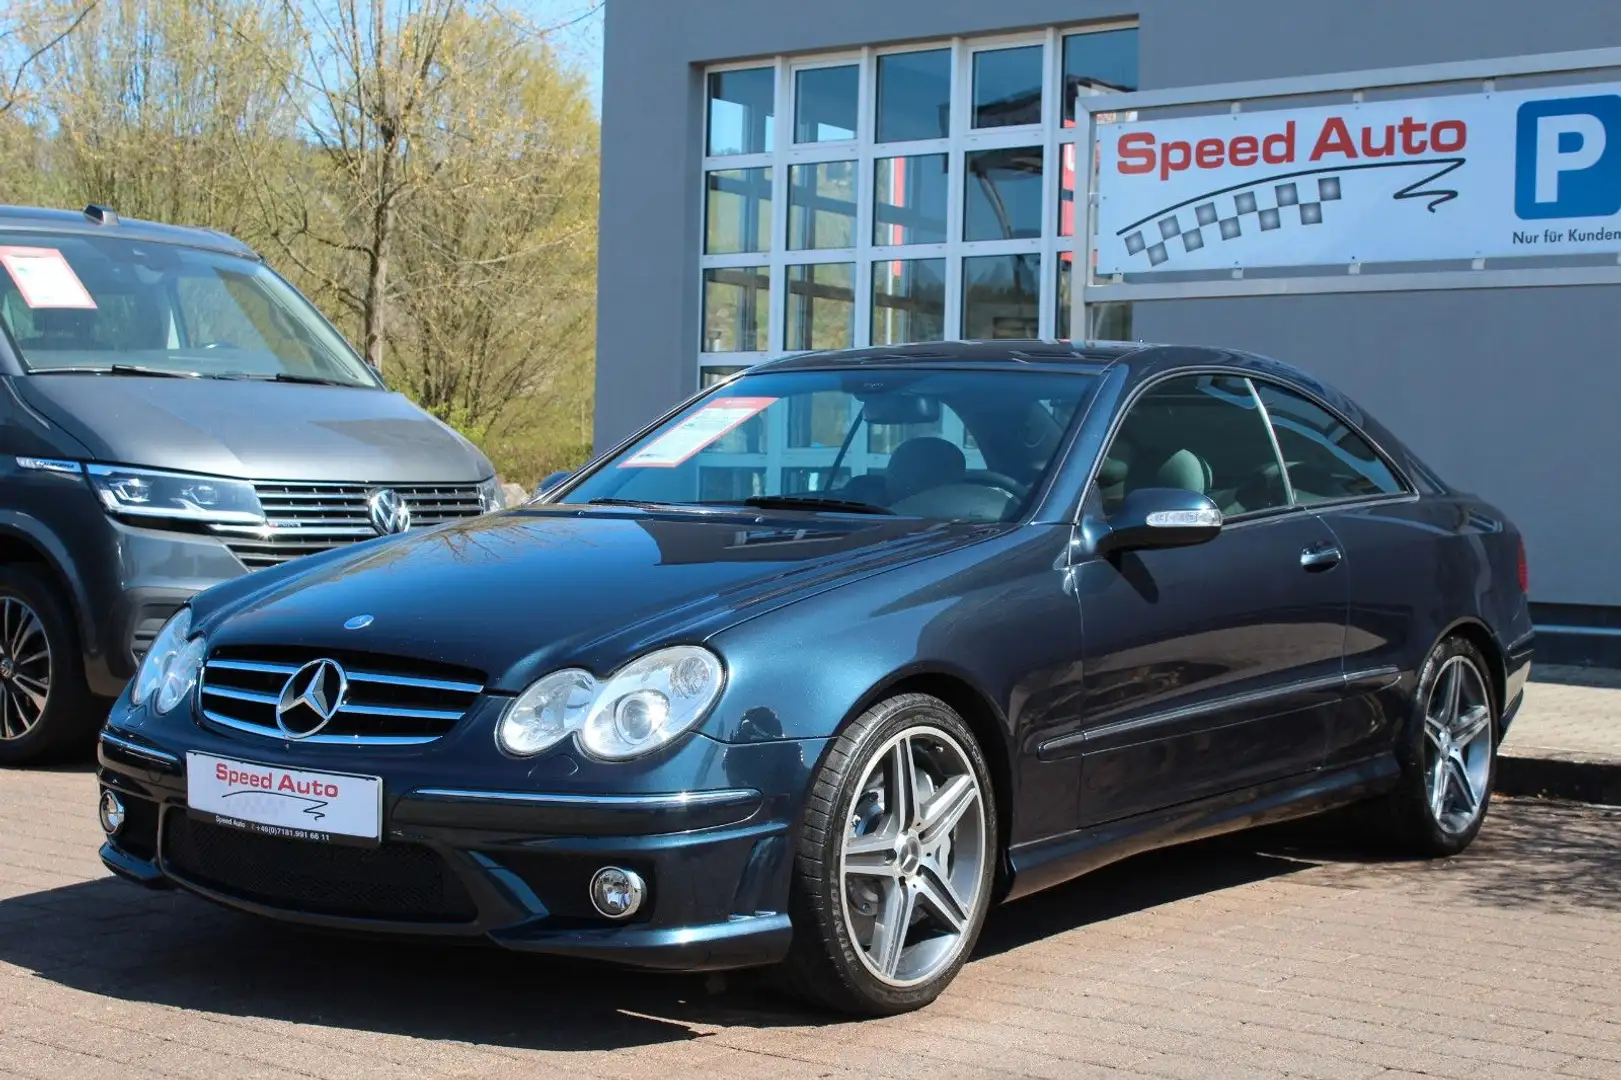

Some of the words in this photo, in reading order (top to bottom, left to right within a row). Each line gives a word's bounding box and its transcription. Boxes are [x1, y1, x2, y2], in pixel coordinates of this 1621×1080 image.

[1117, 121, 1297, 181] Speed
[1309, 116, 1468, 161] Auto
[1535, 113, 1607, 203] P
[1512, 231, 1540, 245] Nur
[1543, 228, 1564, 244] für
[1568, 226, 1621, 242] Kunden
[216, 762, 273, 789] Speed
[277, 774, 339, 798] Auto
[216, 815, 232, 826] Speed
[233, 819, 246, 828] Auto
